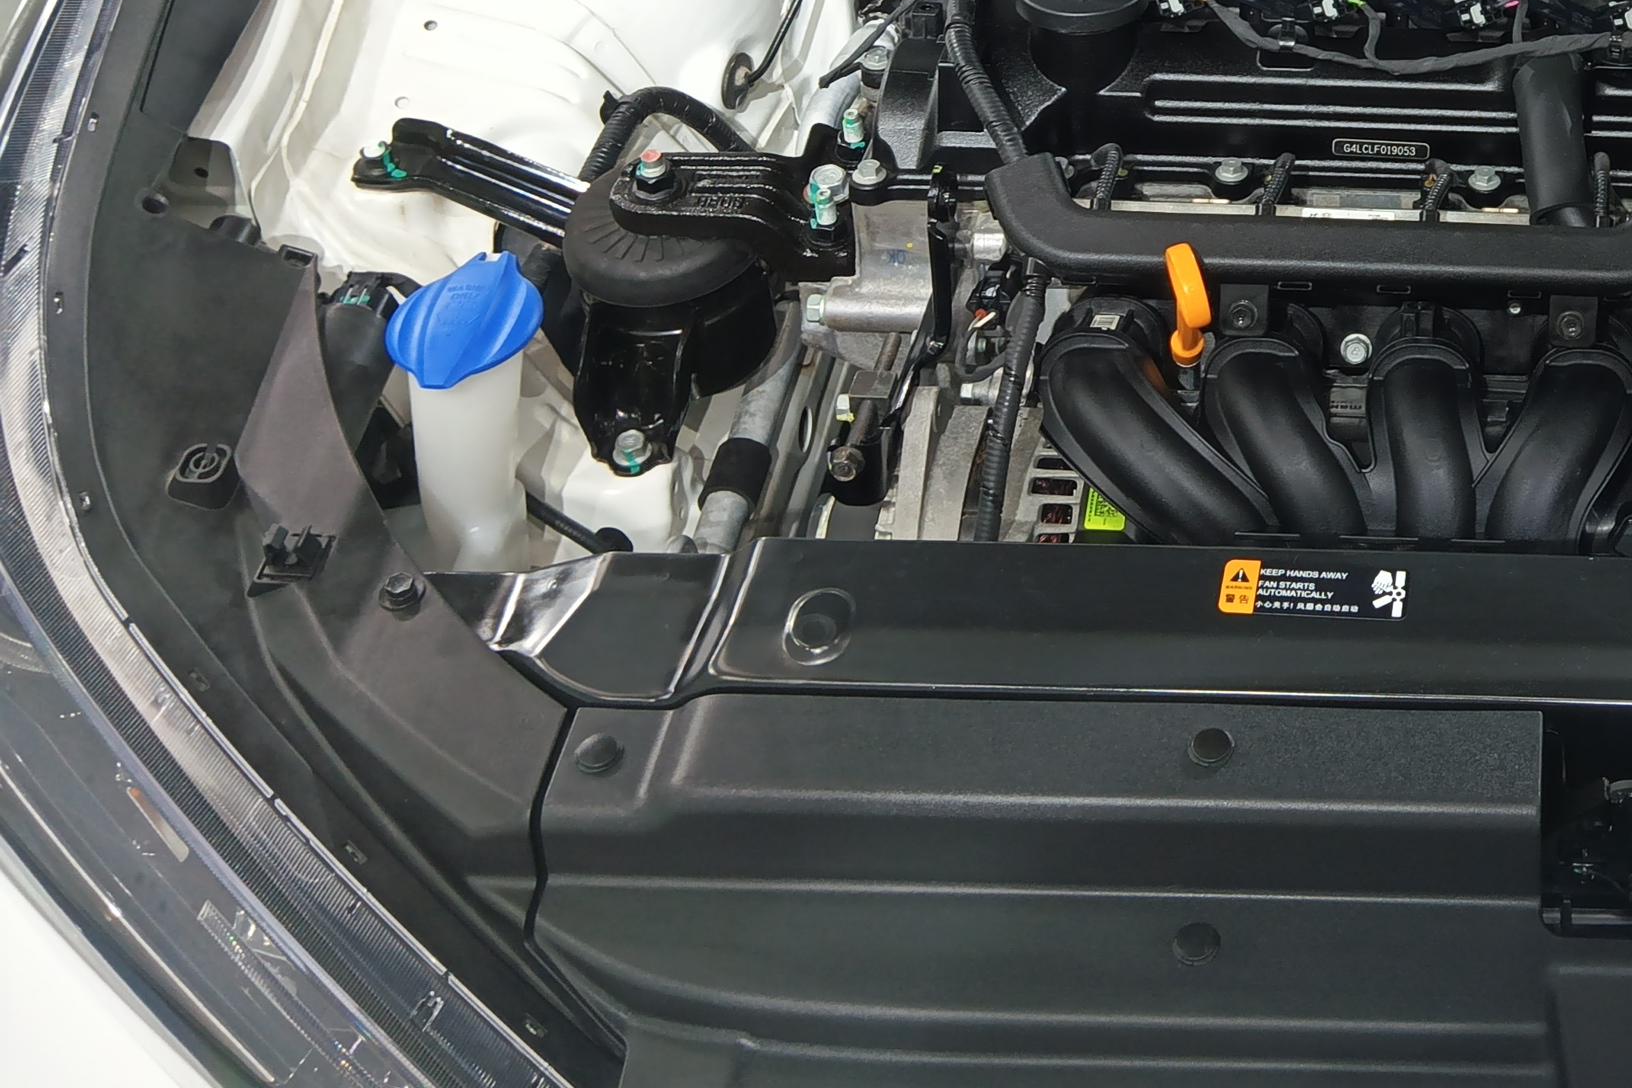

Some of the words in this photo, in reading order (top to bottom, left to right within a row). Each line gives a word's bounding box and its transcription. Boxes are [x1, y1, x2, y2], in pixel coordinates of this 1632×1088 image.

[1343, 143, 1416, 156] G4LCLF019053
[1260, 568, 1285, 576] KEEP
[1286, 570, 1319, 578] HANDS
[1320, 572, 1348, 580] AWAY
[1279, 581, 1315, 590] STARTS
[1256, 589, 1334, 600] AUTOMATICALLY
